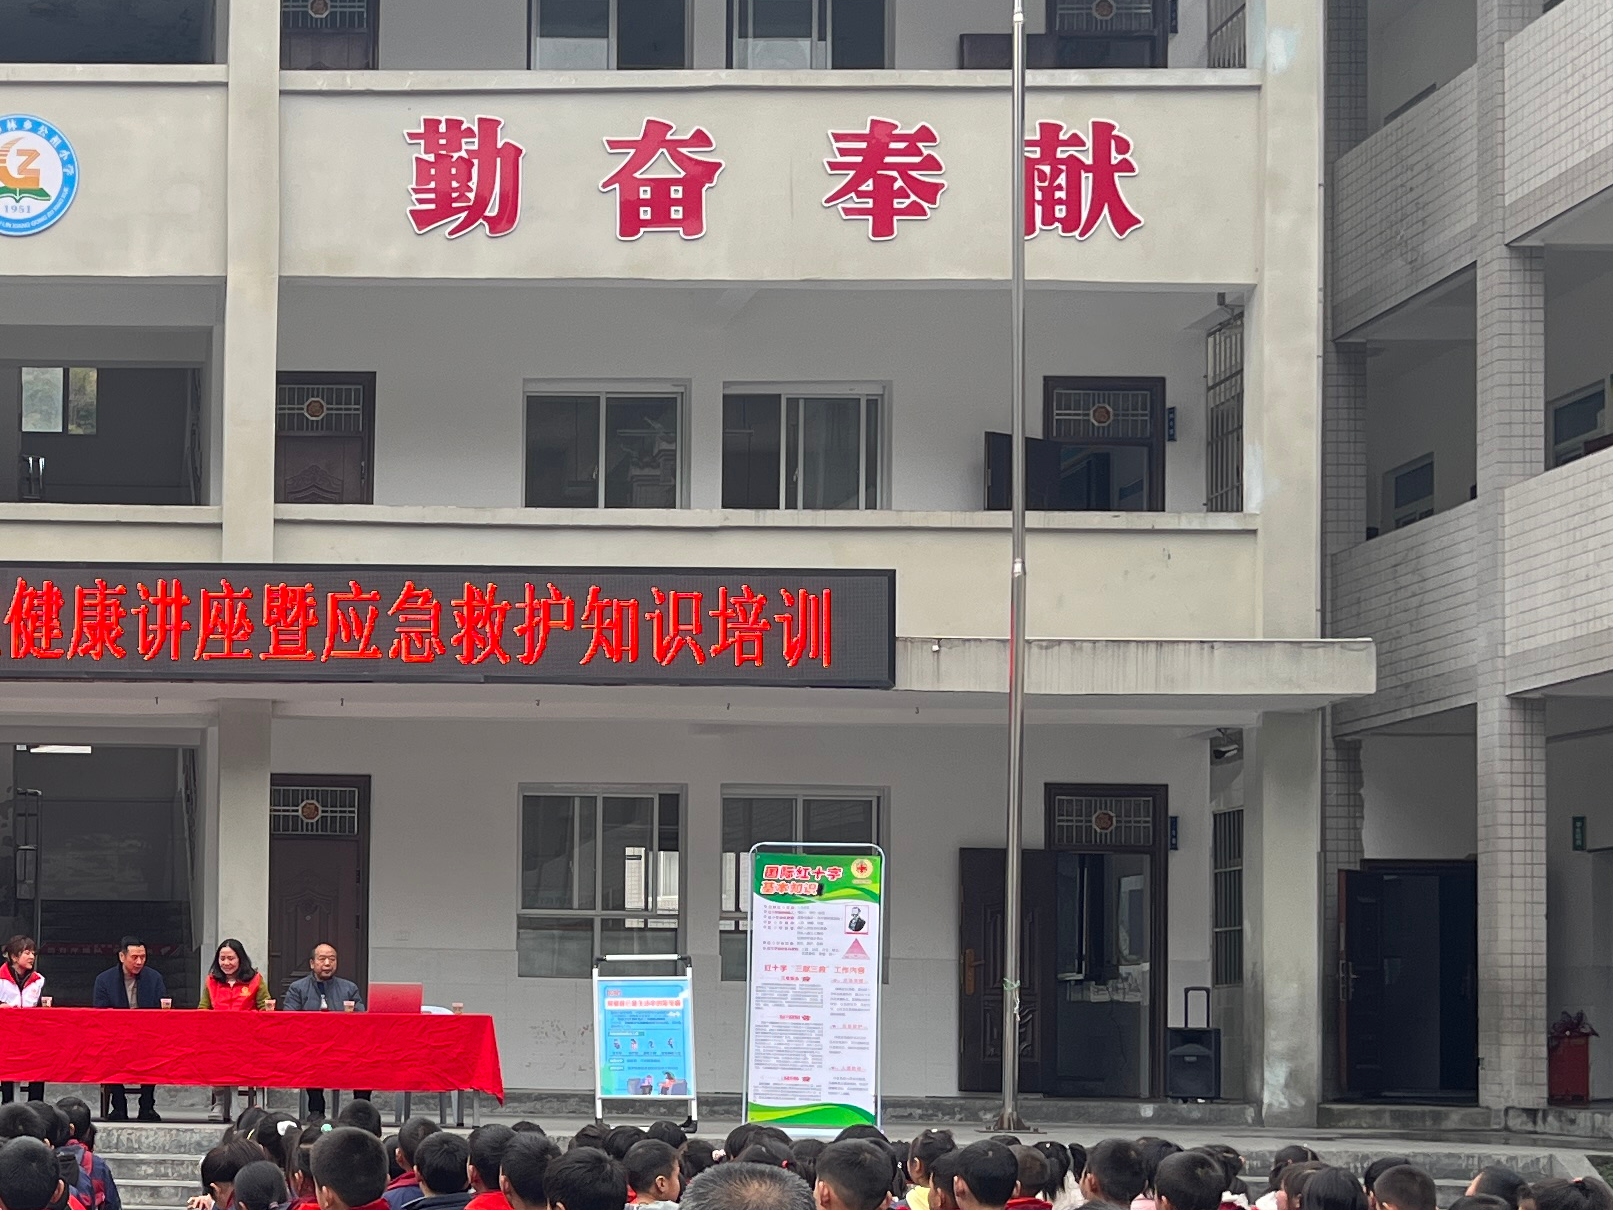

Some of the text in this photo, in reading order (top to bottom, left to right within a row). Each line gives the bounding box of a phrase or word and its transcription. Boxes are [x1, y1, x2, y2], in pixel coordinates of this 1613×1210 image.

[4, 204, 32, 214] 1951
[763, 865, 844, 880] 国际红十字
[760, 881, 820, 896] 基本知识
